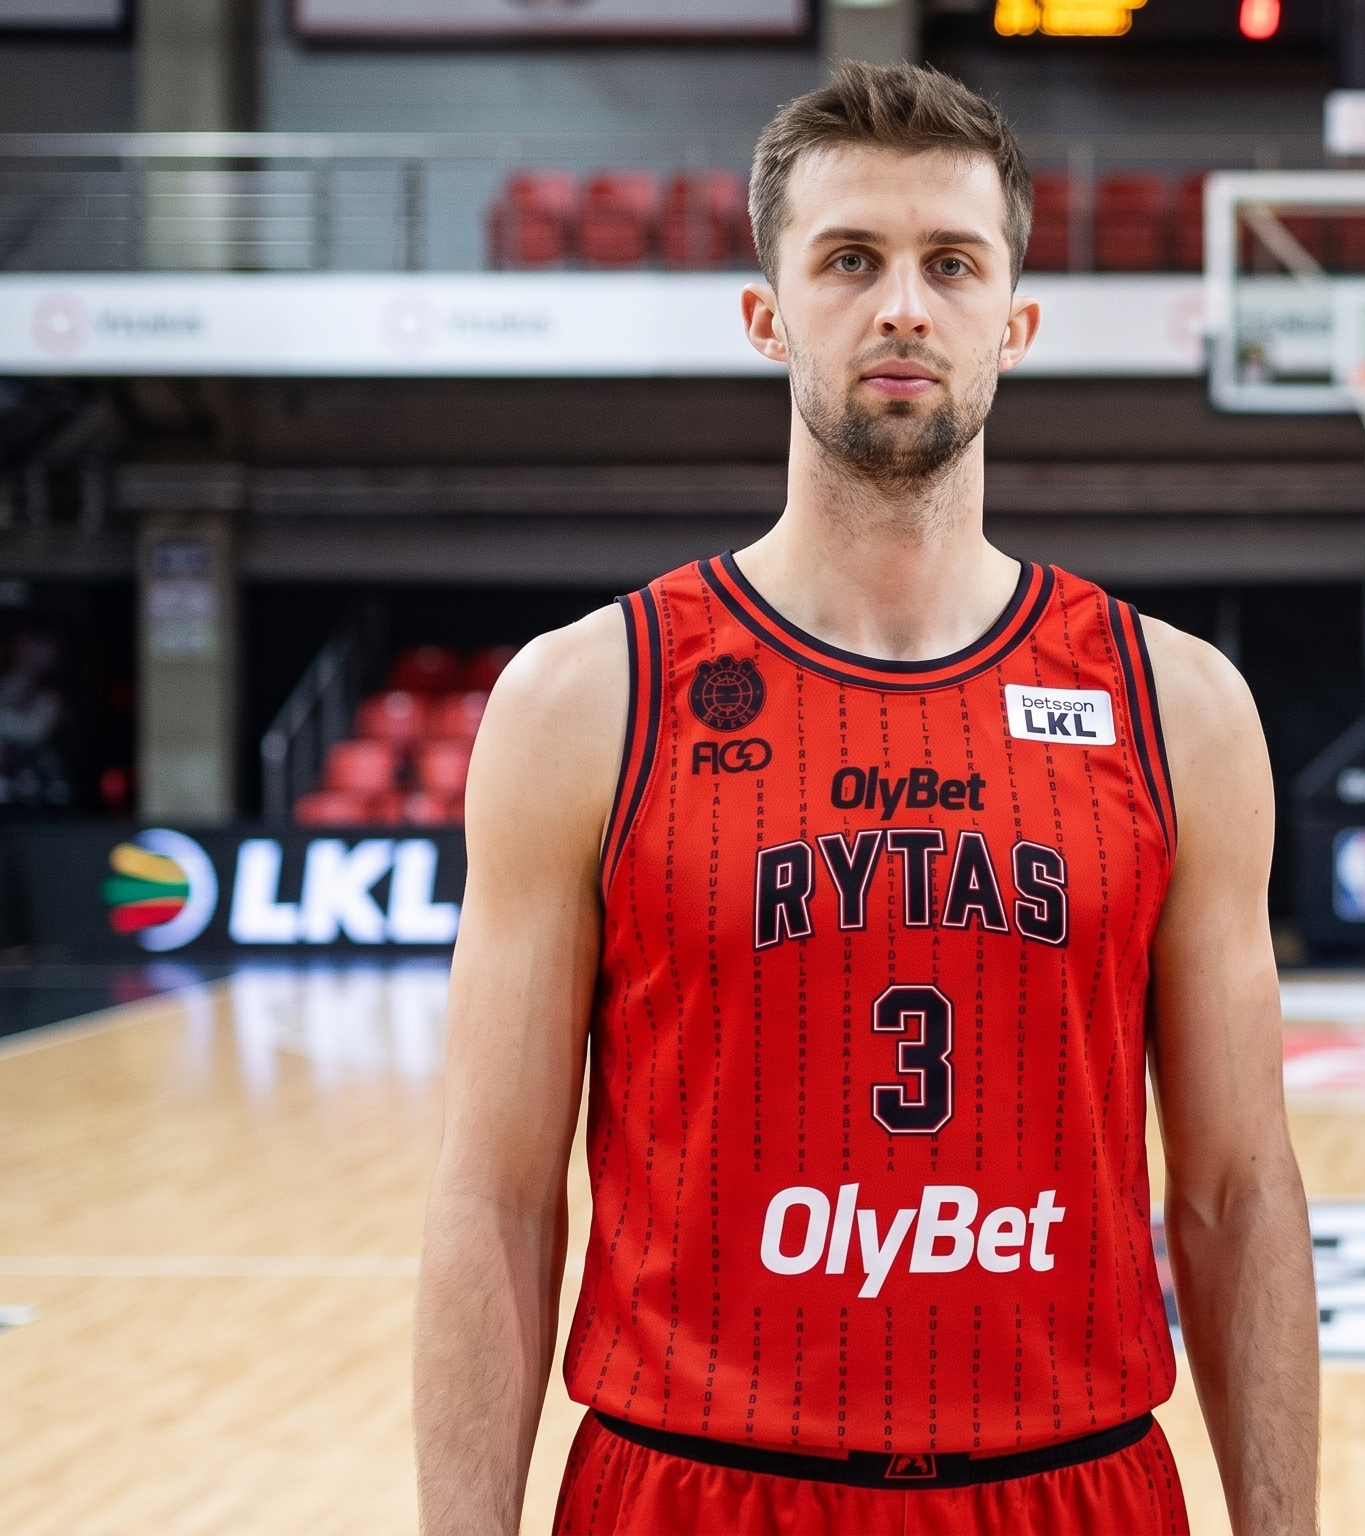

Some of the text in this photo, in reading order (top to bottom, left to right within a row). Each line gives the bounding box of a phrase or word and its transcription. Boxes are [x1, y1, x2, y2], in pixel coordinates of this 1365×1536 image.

[1021, 694, 1095, 713] betsson
[1024, 709, 1097, 738] LKL
[831, 766, 986, 821] OlyBet
[228, 838, 460, 944] LKL
[753, 827, 1070, 952] RYTAS
[870, 982, 955, 1135] 3
[760, 1182, 1066, 1298] OlyBet
